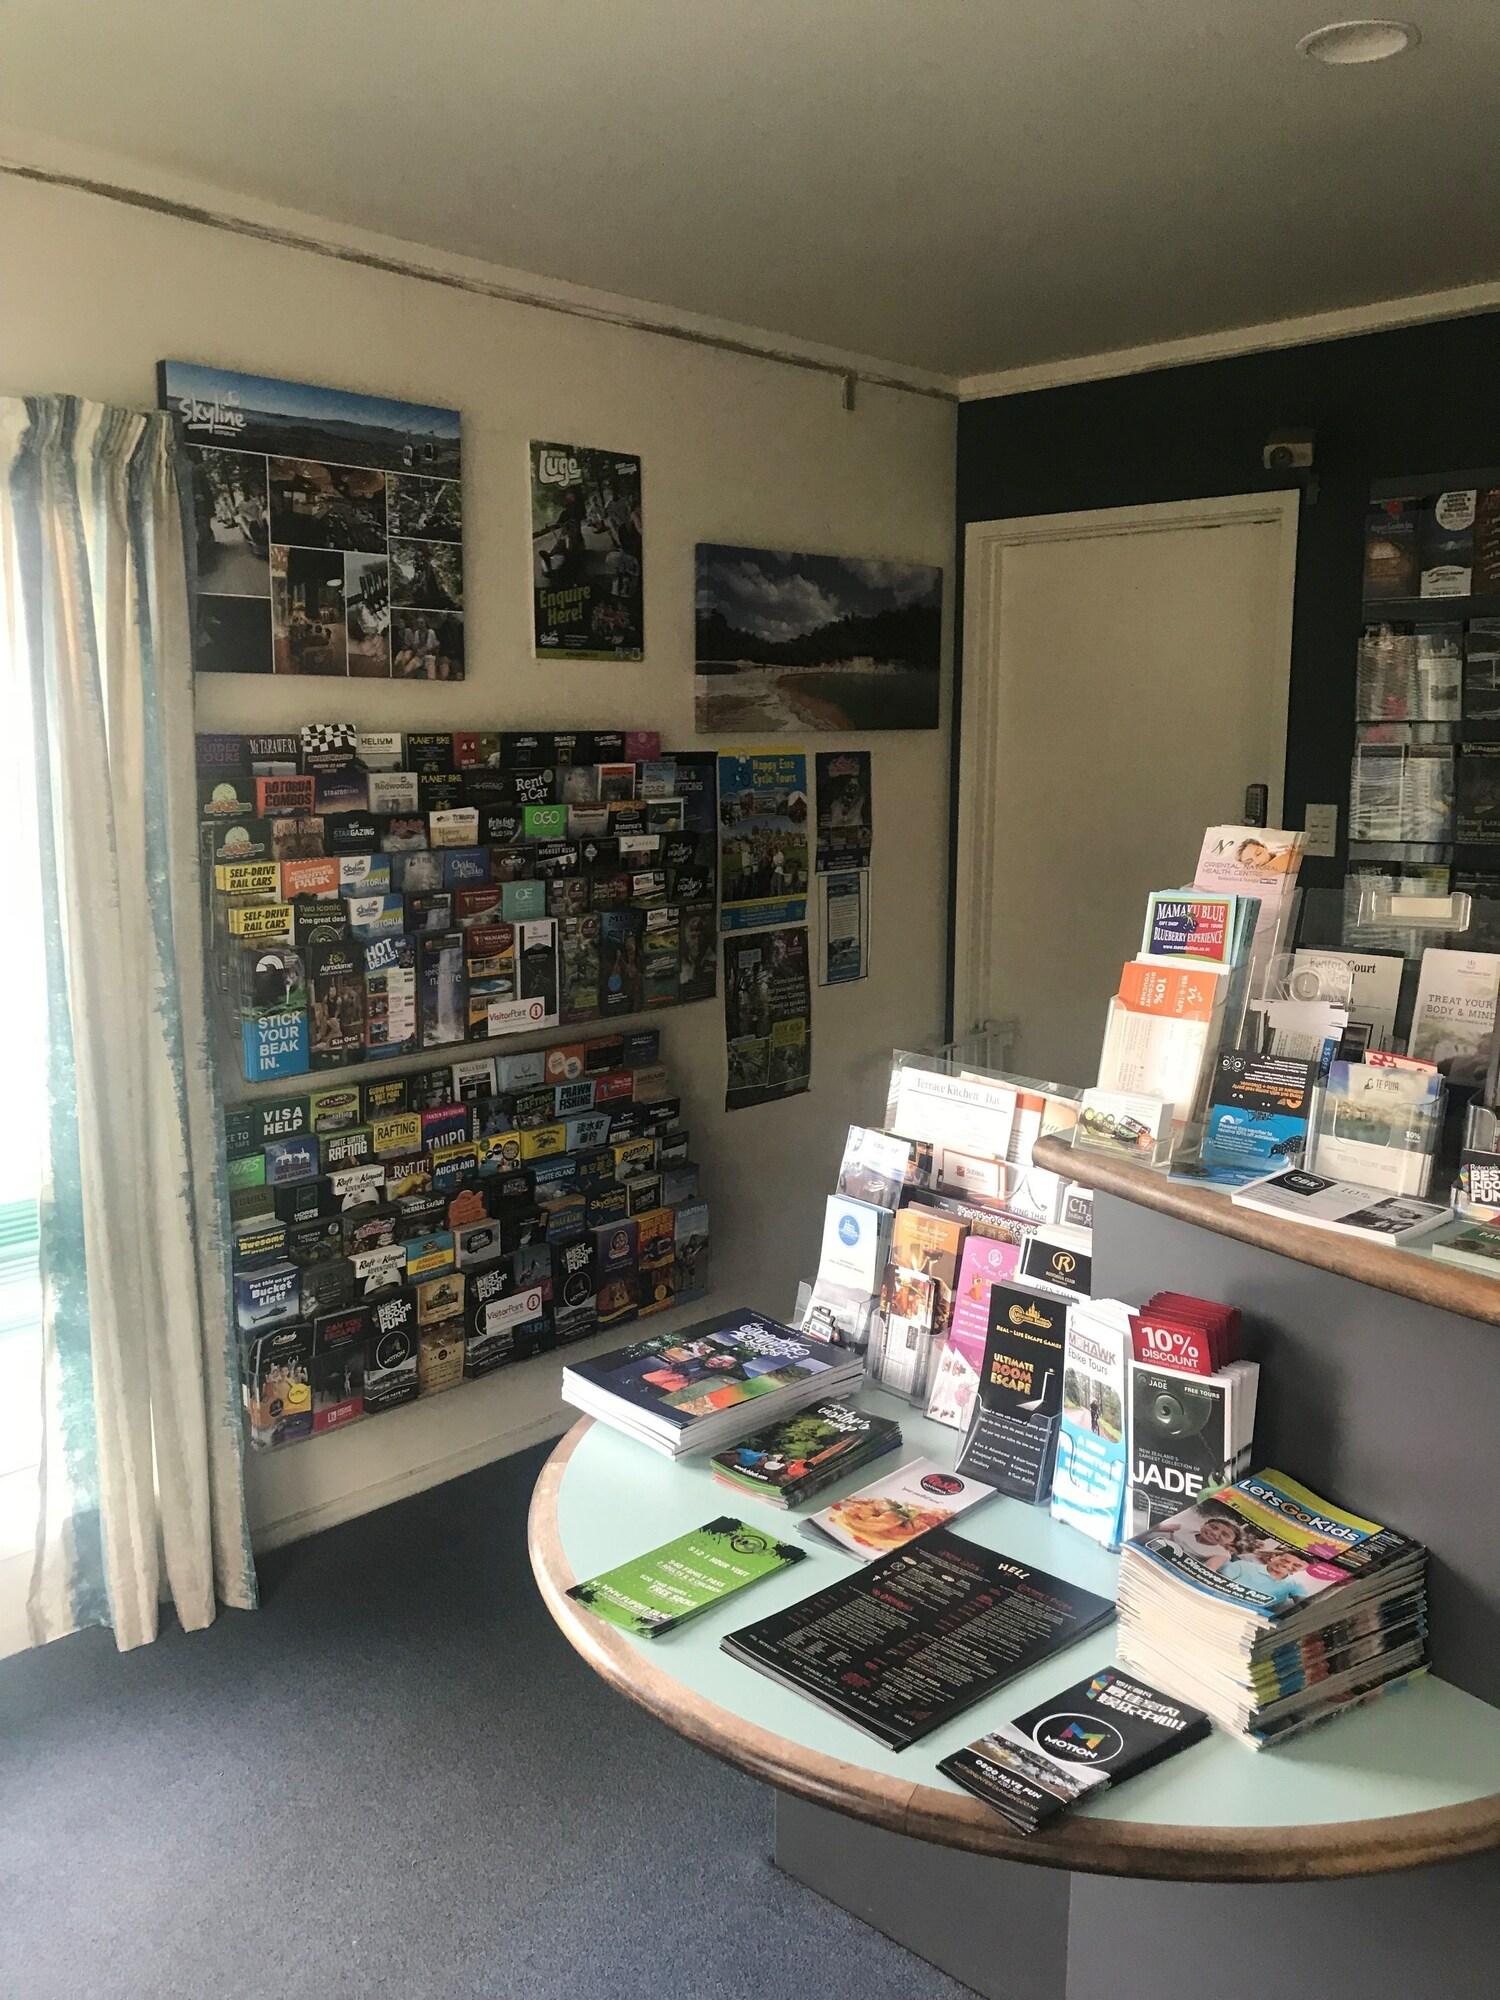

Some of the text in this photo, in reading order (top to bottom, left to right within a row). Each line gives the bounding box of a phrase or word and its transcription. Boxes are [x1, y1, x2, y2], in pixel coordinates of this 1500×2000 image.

[178, 398, 247, 434] Skyline
[539, 449, 583, 487] Luge
[539, 585, 591, 608] Enquire
[547, 606, 582, 627] Here!
[409, 736, 434, 745] PLANET
[265, 780, 312, 793] ROTORUA
[420, 775, 447, 784] PLANET
[515, 776, 544, 793] Rent
[265, 793, 312, 807] COMBOS
[520, 786, 549, 802] a Car
[533, 811, 559, 825] OGO
[230, 865, 275, 878] SELF-DRIVE
[1204, 861, 1240, 870] ORIENTAL
[230, 876, 272, 888] RAIL CARS
[294, 876, 330, 889] PARK
[243, 908, 289, 921] SELF-DRIVE
[299, 904, 313, 913] Two
[1156, 903, 1226, 923] MAMAKU BLUE
[243, 919, 286, 932] RAIL CARS
[299, 915, 346, 925] One great deal
[1153, 926, 1224, 944] BLUEBERRY EXPERIENCE
[365, 938, 392, 962] HOT
[320, 961, 353, 973] Agrodome
[368, 950, 399, 970] DEALS!
[1347, 959, 1377, 974] Court
[1139, 971, 1151, 1007] VOUCHER
[1145, 971, 1157, 1007] DISCOUNT
[1153, 977, 1167, 1005] 10%
[1428, 994, 1494, 1008] TREAT YOUR
[258, 1012, 302, 1029] STICK
[489, 1008, 527, 1021] VisitorPoint
[1426, 1004, 1498, 1020] BODY & MIND
[258, 1026, 300, 1042] YOUR
[259, 1039, 300, 1056] BEAK
[260, 1055, 280, 1071] IN.
[561, 1083, 592, 1099] PRAWN
[917, 1078, 946, 1094] Terrace
[947, 1080, 979, 1101] Kitchen
[1375, 1079, 1399, 1091] TE PUIA
[559, 1094, 592, 1111] FISHING
[263, 1106, 303, 1123] VISA
[263, 1119, 303, 1136] HELP
[377, 1120, 416, 1139] RAFTING
[1406, 1130, 1421, 1140] 10%
[426, 1128, 466, 1150] TAUPO
[328, 1142, 368, 1162] RAFTING
[393, 1158, 430, 1178] RAFT IT!
[435, 1159, 475, 1177] AUCKLAND
[536, 1167, 576, 1184] WHITE ISLAND
[1470, 1163, 1499, 1171] Rotorua's
[336, 1177, 353, 1188] Raft
[1289, 1175, 1319, 1188] CBK
[239, 1233, 285, 1251] Awesome
[359, 1259, 375, 1270] Raft
[249, 1281, 261, 1290] Put
[262, 1278, 274, 1287] this
[283, 1273, 297, 1284] your
[251, 1279, 293, 1299] Bucket
[259, 1292, 287, 1307] List!
[487, 1303, 524, 1320] VisitorPoint
[381, 1312, 408, 1333] FUN!
[996, 1325, 1009, 1333] REAL
[1013, 1330, 1024, 1340] LIFE
[1024, 1333, 1044, 1344] ESCAPE
[1043, 1338, 1062, 1350] GAMES
[1141, 1326, 1199, 1358] 10%
[1068, 1331, 1117, 1366] MOHAWK
[994, 1353, 1035, 1373] ULTIMATE
[1068, 1347, 1108, 1375] Ebike Tours
[1142, 1348, 1199, 1368] DISCOUNT
[992, 1361, 1033, 1384] ROOM
[990, 1373, 1032, 1395] ESCAPE
[1149, 1379, 1220, 1399] JADE FREE TOURS
[1138, 1447, 1151, 1455] NEW
[1138, 1453, 1161, 1463] LARGEST
[1161, 1457, 1193, 1471] COLLECTION
[1132, 1460, 1204, 1497] JADE
[1239, 1479, 1361, 1542] LetsGoKids
[684, 1565, 707, 1581] FAMILY
[708, 1575, 727, 1587] PASS
[997, 1562, 1031, 1580] HELL
[1183, 1554, 1229, 1585] Discover
[1229, 1579, 1248, 1593] the
[649, 1584, 699, 1608] FREE SOCKS
[1043, 1734, 1099, 1760] MOTION
[975, 1758, 1043, 1799] 0800 HAVE FUN
